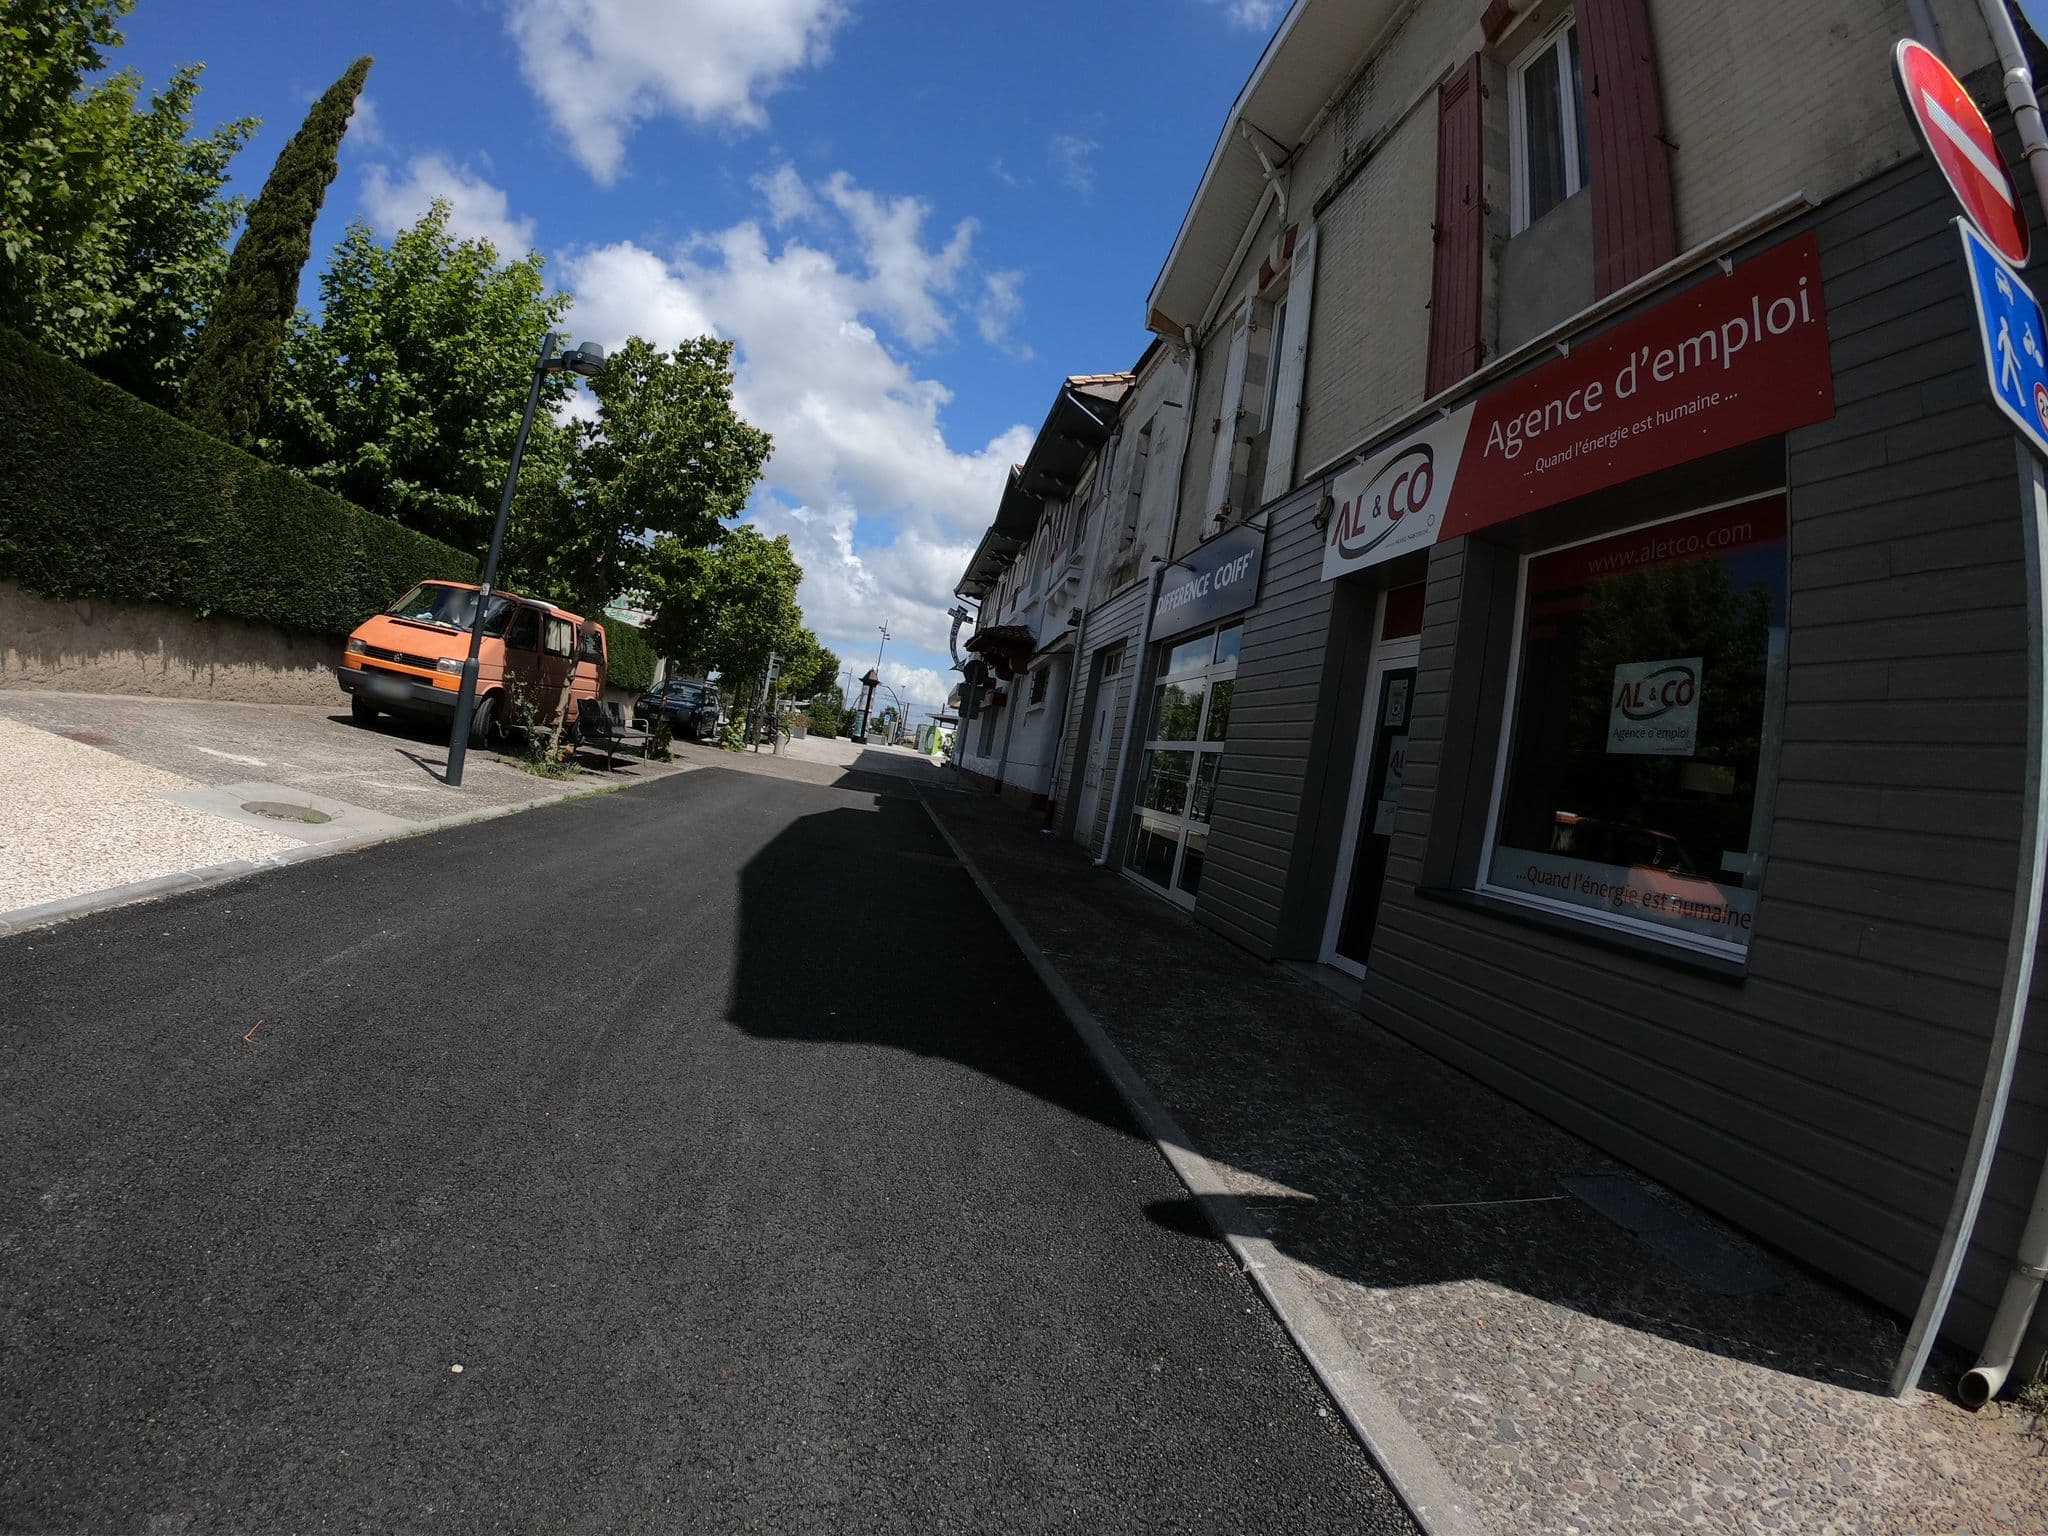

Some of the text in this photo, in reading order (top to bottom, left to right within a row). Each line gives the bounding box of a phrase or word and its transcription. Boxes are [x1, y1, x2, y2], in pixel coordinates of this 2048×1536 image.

[1483, 275, 1811, 459] Agence d'emploi
[1535, 442, 1573, 474] Quand
[1574, 424, 1629, 456] l'énergie
[1632, 413, 1654, 436] est
[1656, 388, 1720, 426] humaine
[1331, 462, 1433, 546] AL & CO
[1586, 520, 1752, 574] www.aletco.com
[1156, 549, 1255, 616] DIFFERENCE COIFF'
[1616, 679, 1695, 708] AL & CO
[1613, 727, 1646, 742] Agence
[1573, 873, 1639, 907] l'énergie
[1642, 890, 1668, 911] est
[1671, 895, 1752, 930] humaine
